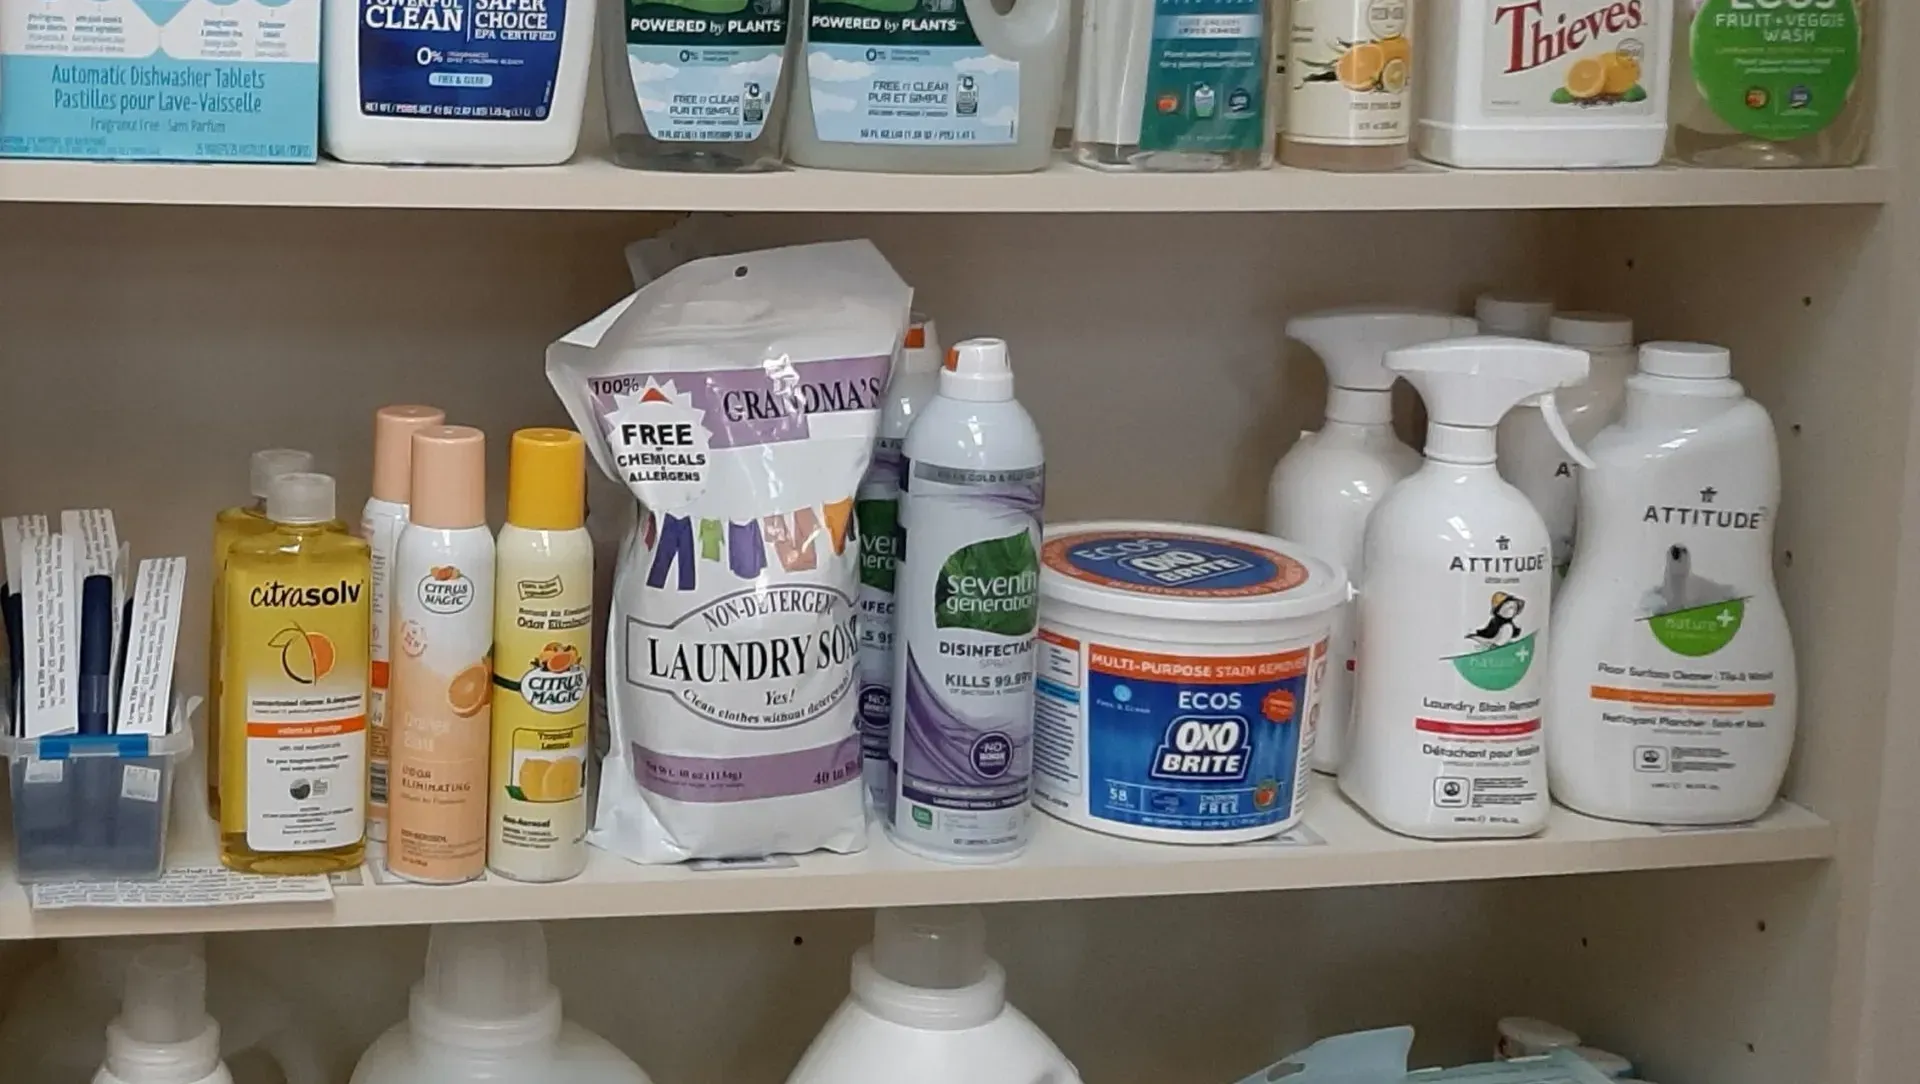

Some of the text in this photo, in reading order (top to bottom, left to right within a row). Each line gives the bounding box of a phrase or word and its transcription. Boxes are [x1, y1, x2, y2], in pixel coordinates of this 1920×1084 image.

[365, 4, 464, 32] CLEAN
[475, 12, 548, 30] CHOICE
[630, 18, 782, 36] POWERED by PLANTS
[811, 15, 957, 33] POWERED by PLANTS
[1715, 13, 1771, 28] FRUIT
[1784, 12, 1846, 28] VEGGIE
[475, 28, 557, 41] EPA CERTIFIED
[1494, 0, 1642, 74] Thieves
[1763, 28, 1816, 42] WASH
[416, 46, 444, 66] 0%
[51, 64, 266, 90] Automatic Dishwasher Tablets
[872, 80, 949, 93] FREE CLEAR
[54, 87, 263, 115] Pastilles pour Lave-Vaisselle
[673, 94, 740, 105] FREE CLEAR
[908, 93, 948, 105] SIMPLE
[592, 376, 882, 423] 100% GRANDMA'S
[621, 423, 694, 446] FREE
[616, 453, 707, 467] CHEMICALS
[628, 469, 701, 483] ALLERGENS
[1643, 505, 1762, 530] ATTITUDE
[1072, 538, 1170, 562] ECOS
[1129, 550, 1207, 572] OXO
[1155, 558, 1241, 582] BRITE
[1449, 553, 1545, 574] ATTITUDE
[424, 582, 468, 596] CITRUS
[946, 570, 1038, 596] seventh
[250, 579, 361, 608] citrasolv
[424, 594, 467, 606] MAGIC
[517, 616, 545, 629] Odor
[647, 633, 812, 684] LAUNDRY
[1091, 653, 1212, 679] MULTI-PURPOSE
[1215, 664, 1256, 678] STAIN
[528, 673, 584, 691] CITRUS
[945, 672, 990, 688] KILLS
[530, 688, 583, 705] MAGIC
[764, 688, 797, 706] Yes!
[1178, 691, 1242, 710] ECOS
[1422, 696, 1476, 714] Laundry
[682, 687, 716, 715] Clean
[717, 706, 761, 724] clothes
[761, 711, 803, 725] without
[1174, 720, 1240, 754] OXO
[1161, 753, 1242, 774] BRITE
[402, 778, 472, 794] ELIMINATING
[1109, 787, 1128, 802] 58
[1199, 802, 1239, 814] FREE
